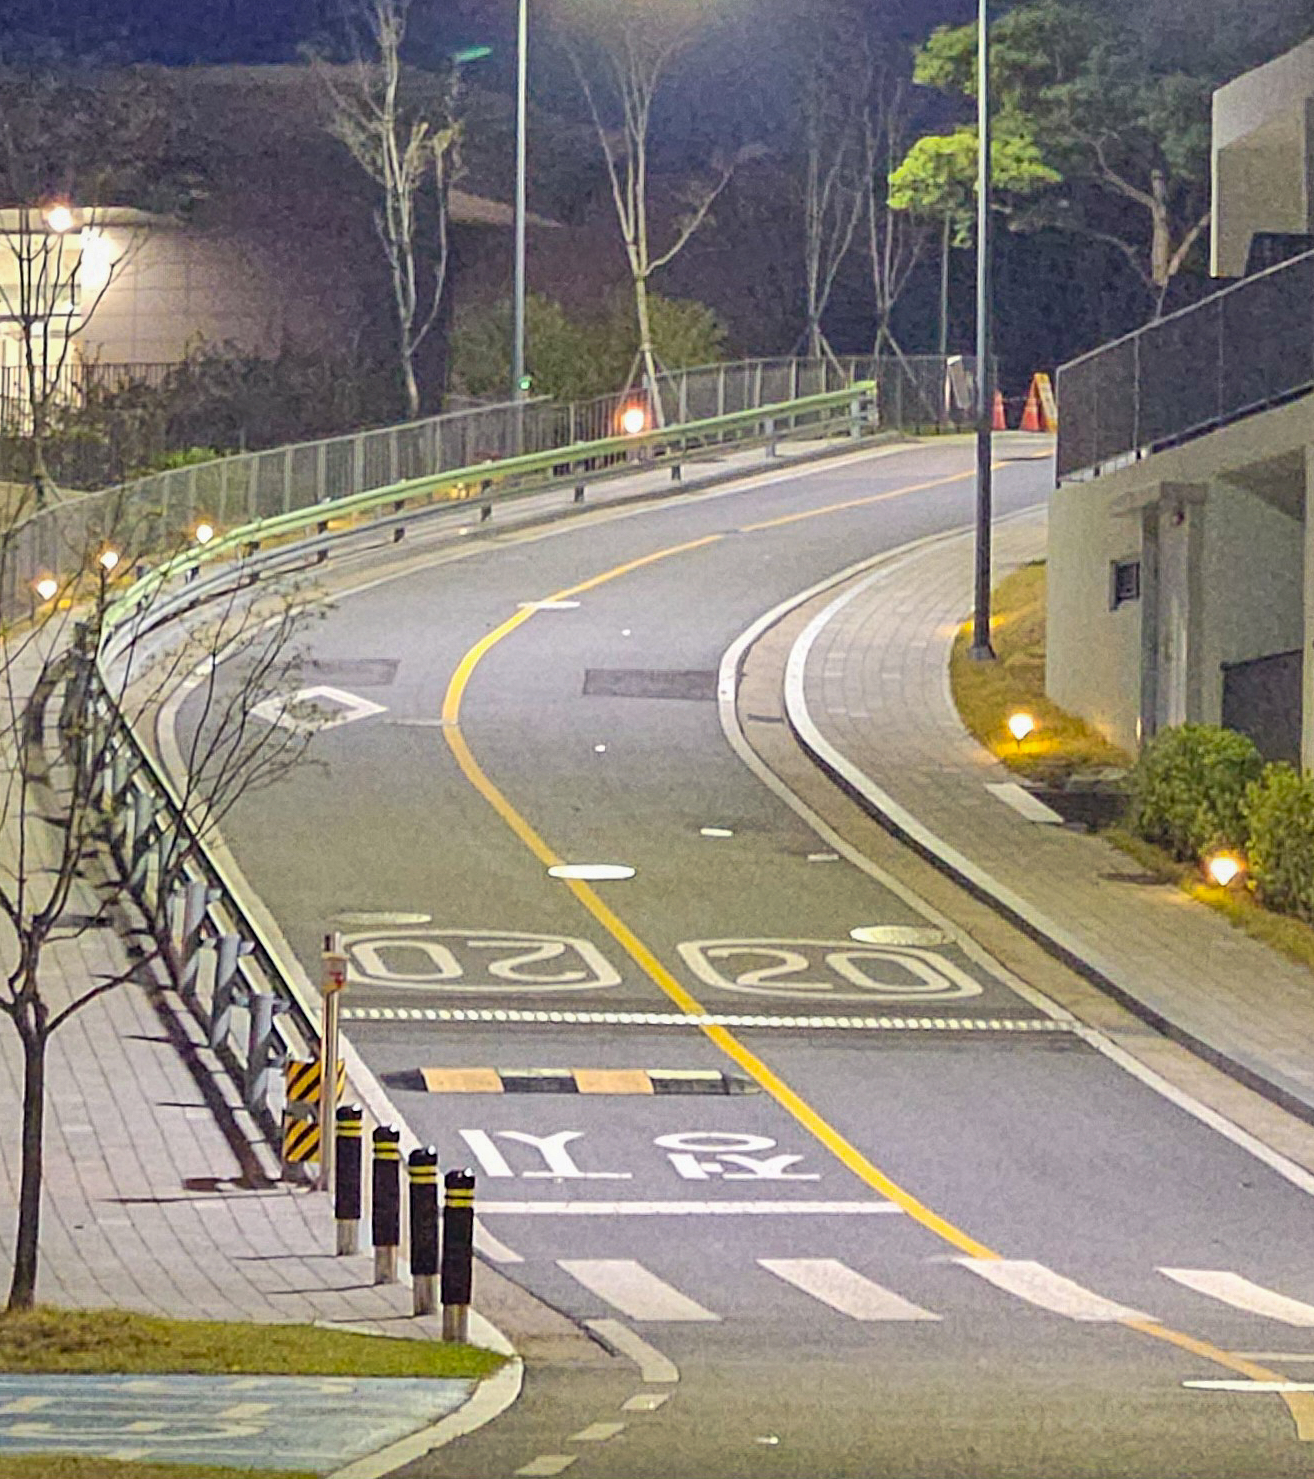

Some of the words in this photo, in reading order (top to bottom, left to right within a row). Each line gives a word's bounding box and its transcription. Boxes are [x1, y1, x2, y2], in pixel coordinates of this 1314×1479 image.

[351, 940, 589, 983] 20
[708, 946, 933, 992] 20
[458, 1129, 821, 1181] 정지
